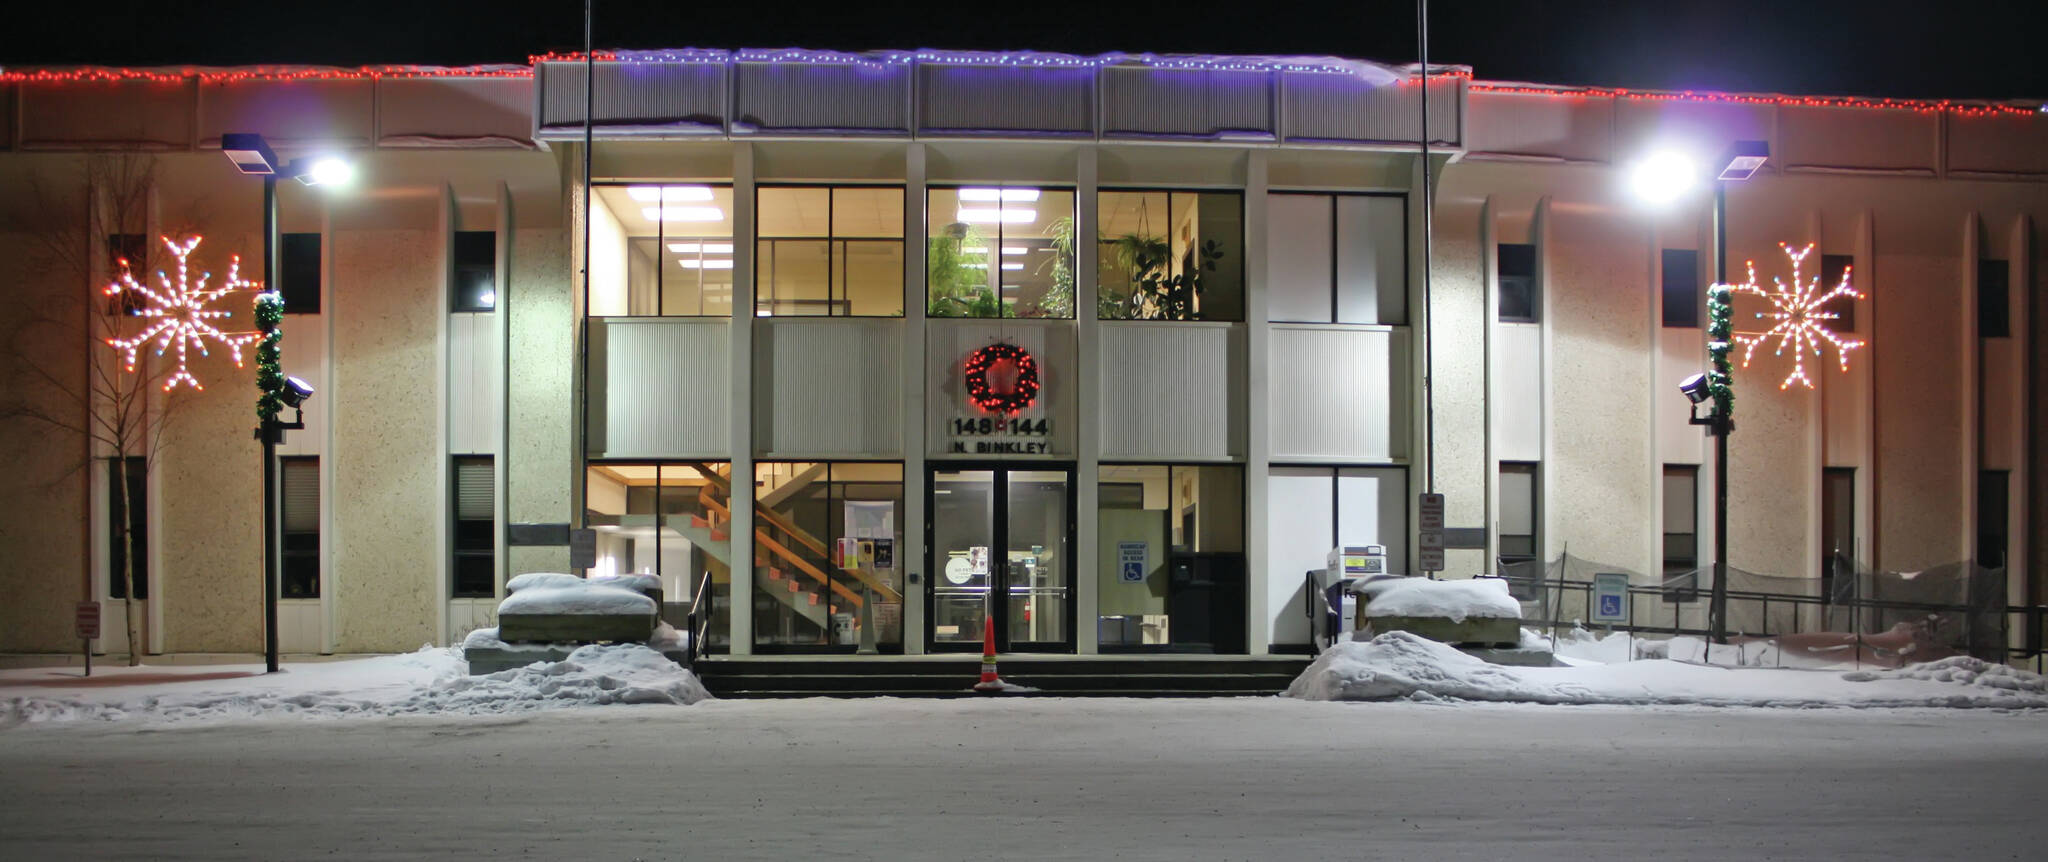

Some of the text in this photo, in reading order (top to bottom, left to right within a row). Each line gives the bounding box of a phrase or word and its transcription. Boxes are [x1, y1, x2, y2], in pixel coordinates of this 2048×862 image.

[954, 418, 1048, 436] 148 144
[976, 442, 1047, 454] BINKLEY
